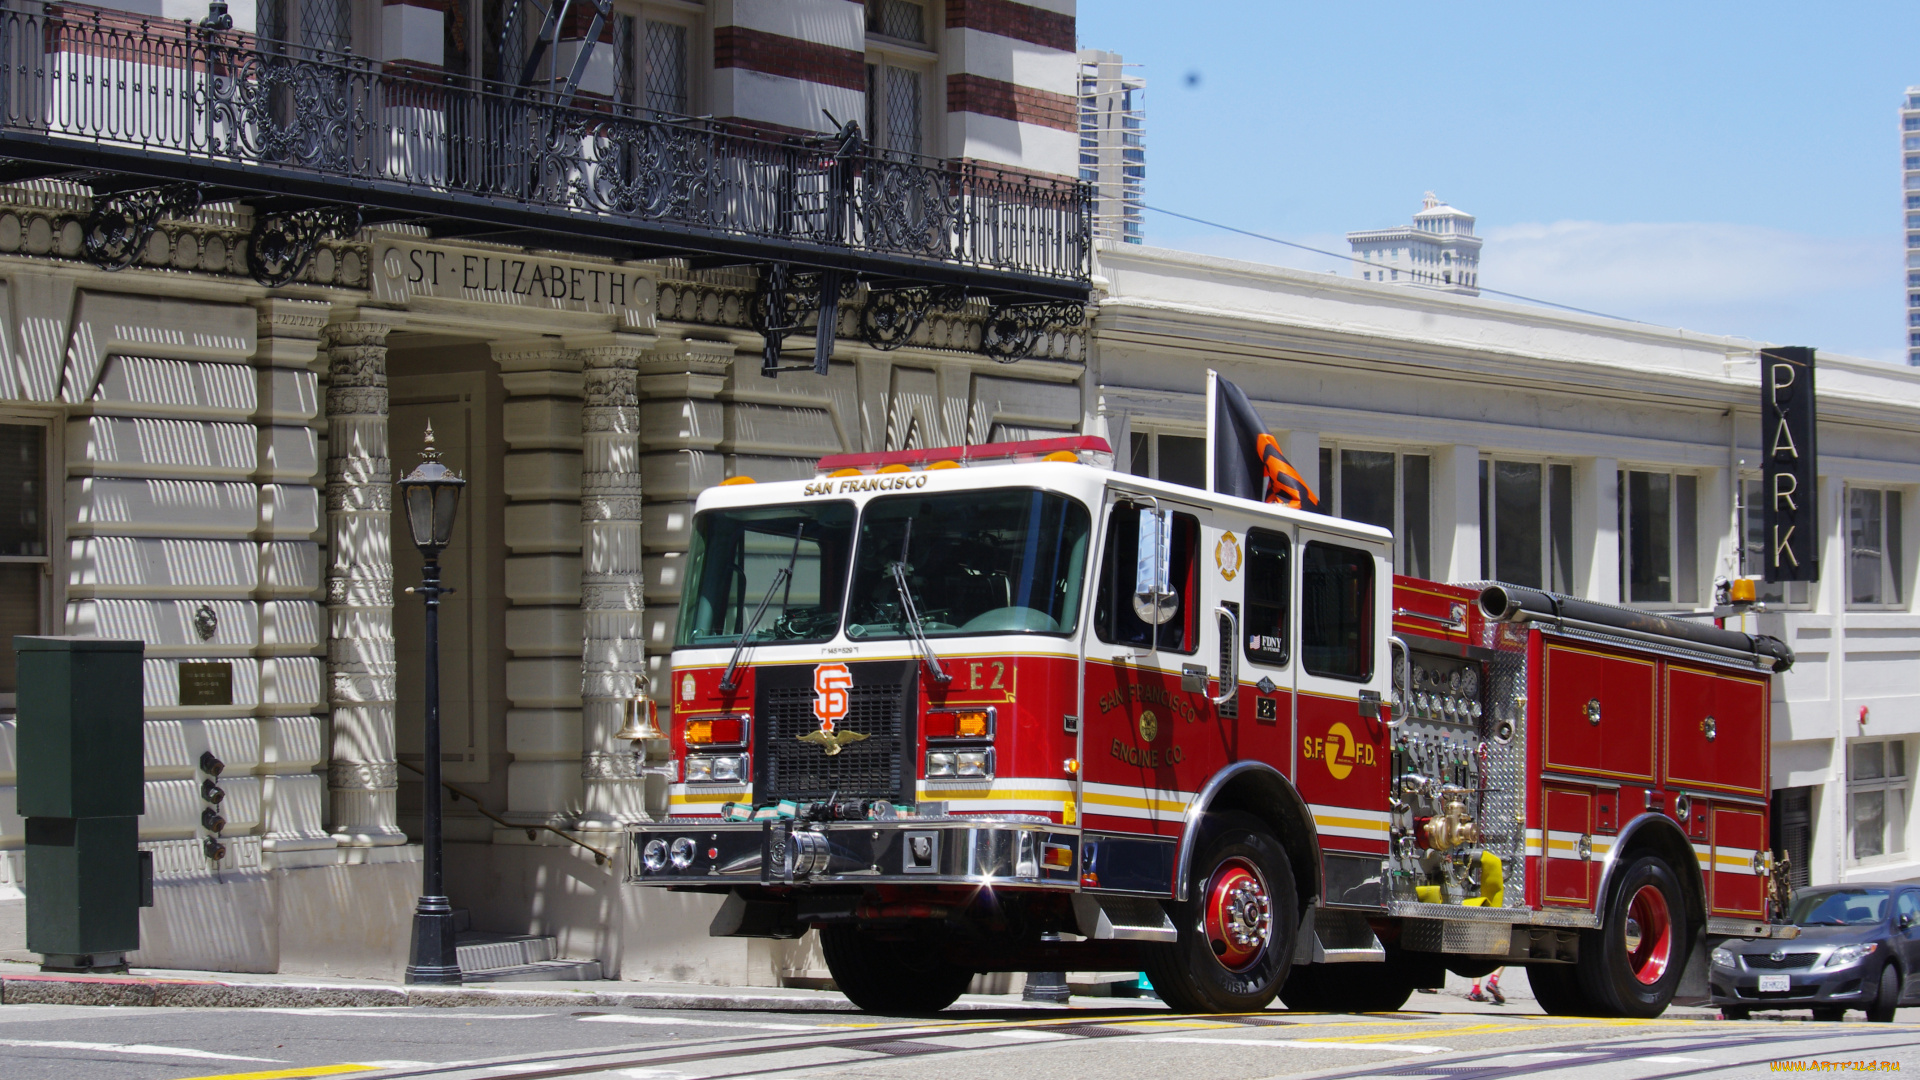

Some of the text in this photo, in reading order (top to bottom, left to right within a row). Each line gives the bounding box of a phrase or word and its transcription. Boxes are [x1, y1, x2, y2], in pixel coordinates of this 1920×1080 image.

[408, 249, 626, 305] ST ELIZABETH
[1771, 363, 1799, 568] PARK
[804, 475, 928, 496] SAN FRANCISCO
[1262, 635, 1282, 648] FDNY
[1099, 684, 1195, 723] SAN FRANCISCO
[1263, 700, 1270, 716] 2
[1110, 737, 1186, 769] ENGINE CO.
[1304, 735, 1325, 760] S.F.
[1356, 743, 1377, 767] F.D.
